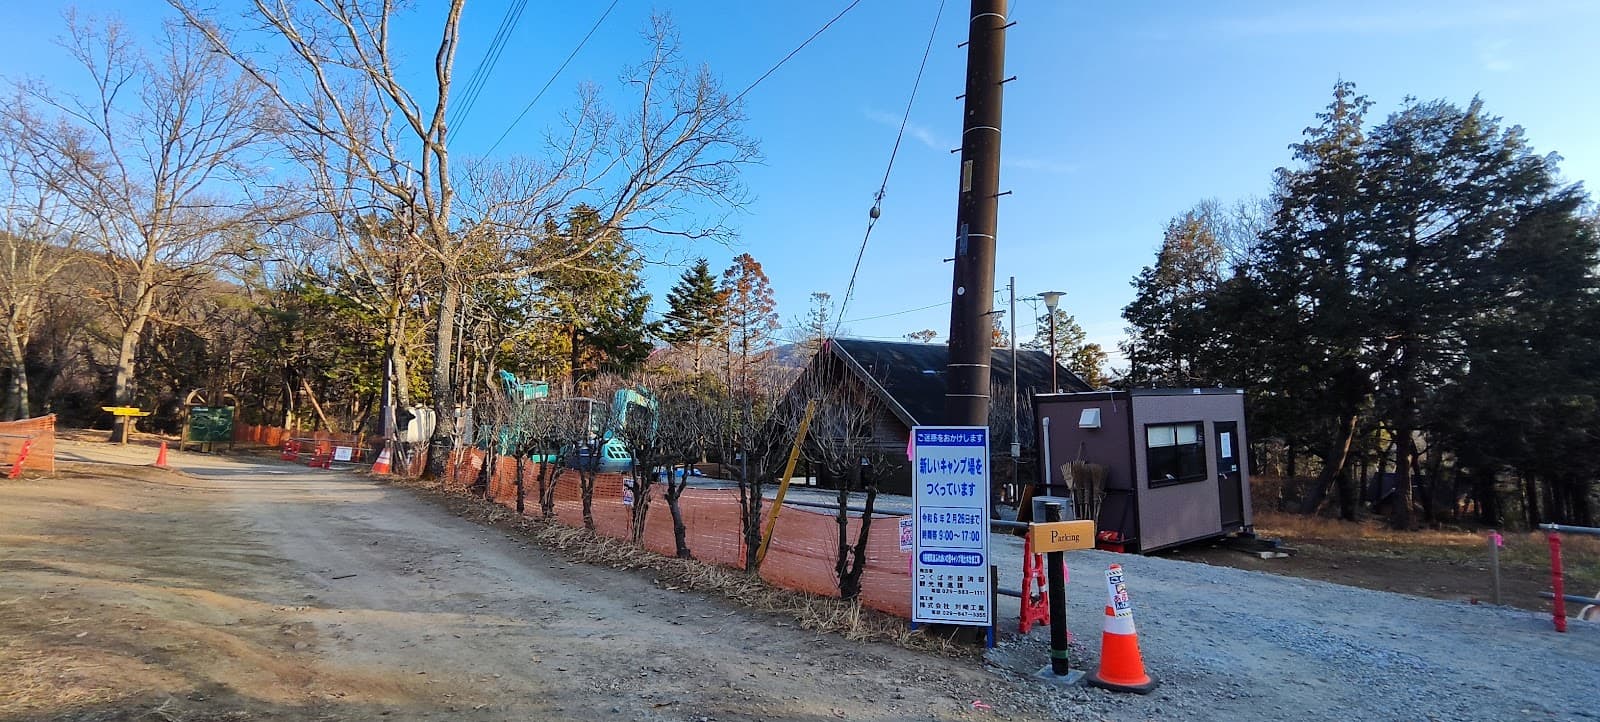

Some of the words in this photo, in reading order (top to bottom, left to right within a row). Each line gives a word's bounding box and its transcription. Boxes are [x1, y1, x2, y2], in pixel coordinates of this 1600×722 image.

[917, 433, 984, 442] ご迷惑をおかけします
[920, 457, 982, 475] 新しいキャンプ場を
[926, 482, 976, 496] つくっています
[1051, 530, 1080, 543] Parking
